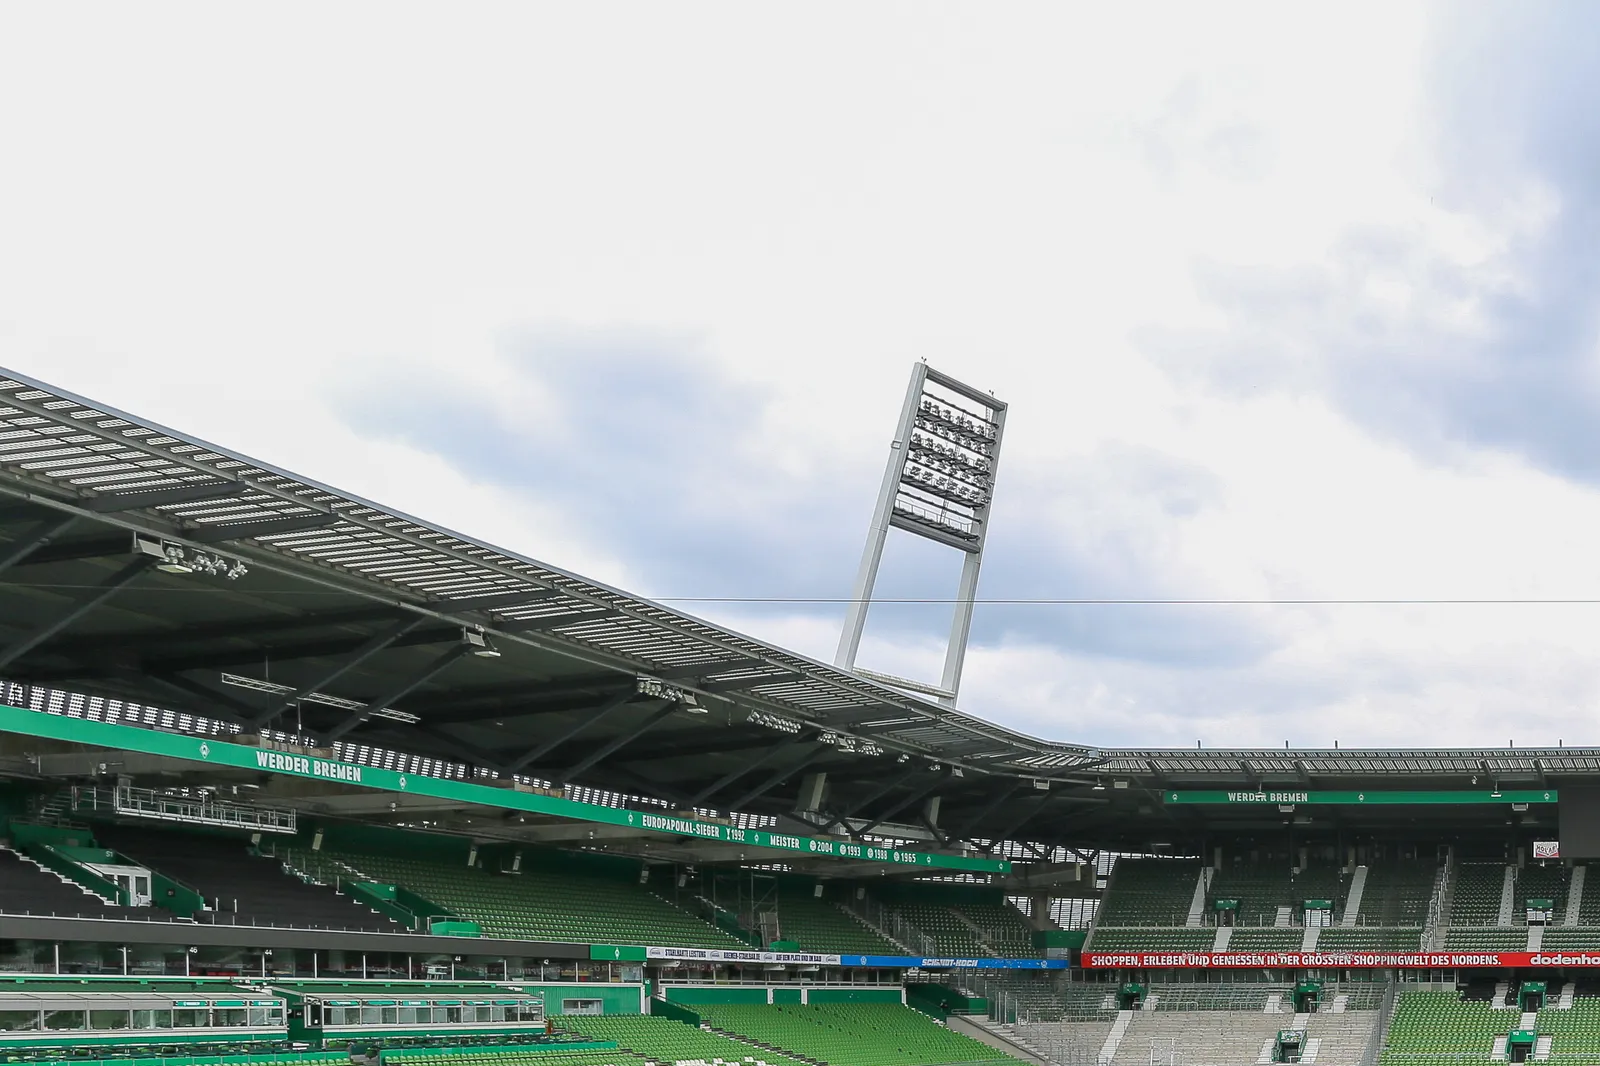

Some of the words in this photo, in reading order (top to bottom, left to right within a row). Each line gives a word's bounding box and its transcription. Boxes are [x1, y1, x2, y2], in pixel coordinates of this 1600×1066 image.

[256, 750, 309, 774] WERDER
[314, 760, 361, 782] BREMEN
[1228, 792, 1267, 802] WERDER
[1270, 792, 1308, 802] BREMEN
[642, 814, 720, 838] EUROPAPOKAL-SIEGER
[770, 834, 800, 849] MEISTER
[1091, 955, 1142, 968] SHOPPEN,
[1143, 955, 1185, 966] ERLEBEN
[1188, 955, 1208, 967] UND
[1213, 955, 1265, 966] GENIESSEN
[1267, 955, 1277, 966] IN
[1280, 955, 1300, 966] DER
[1302, 953, 1352, 966] GRÖSSTEN
[1354, 954, 1430, 966] SHOPPINGWELT
[1431, 954, 1449, 966] DES
[1451, 954, 1501, 966] NORDENS.
